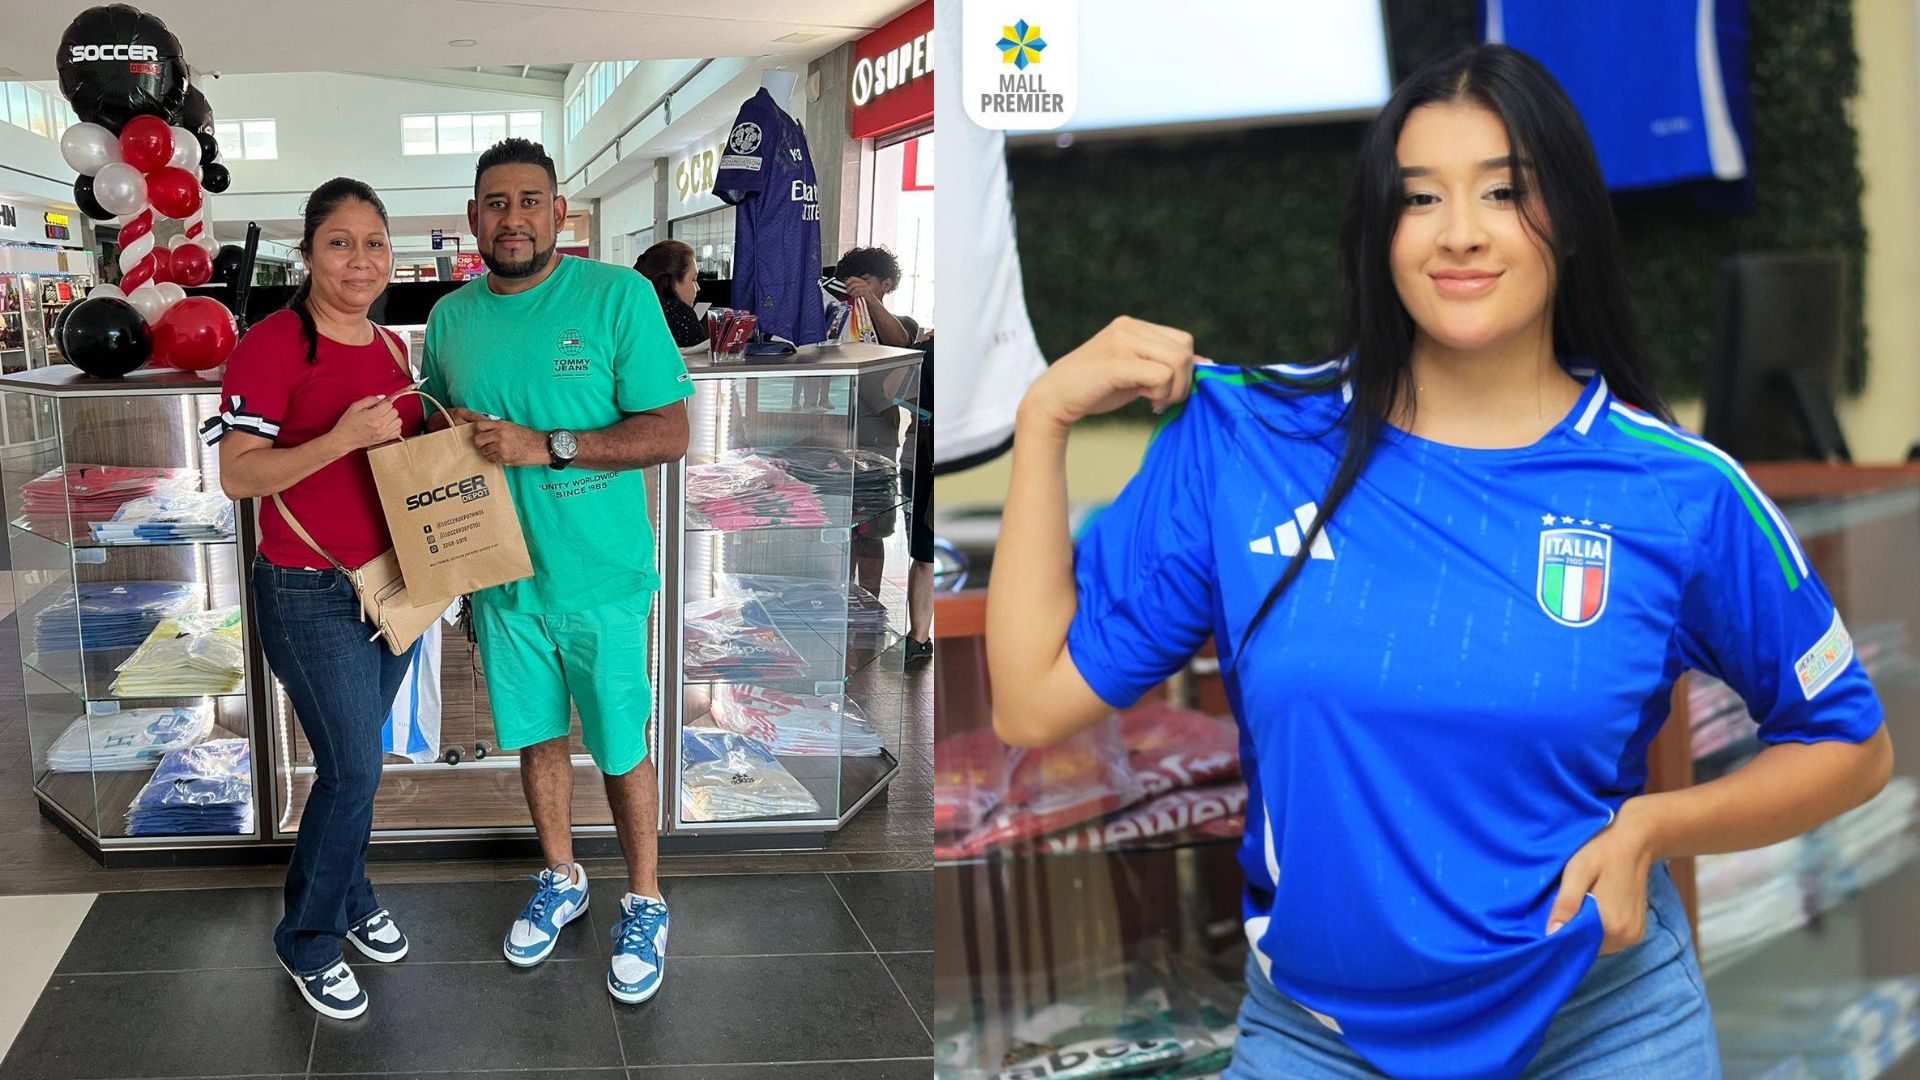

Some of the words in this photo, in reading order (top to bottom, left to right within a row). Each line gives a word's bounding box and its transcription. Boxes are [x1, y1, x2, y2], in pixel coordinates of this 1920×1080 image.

[72, 44, 158, 62] SOCCER
[541, 481, 570, 491] UNITY
[572, 470, 620, 487] WORLDWIDE
[406, 474, 487, 511] SOCCER
[461, 488, 490, 504] DEPOT
[556, 487, 586, 498] SINCE
[1545, 538, 1605, 559] ITALIA
